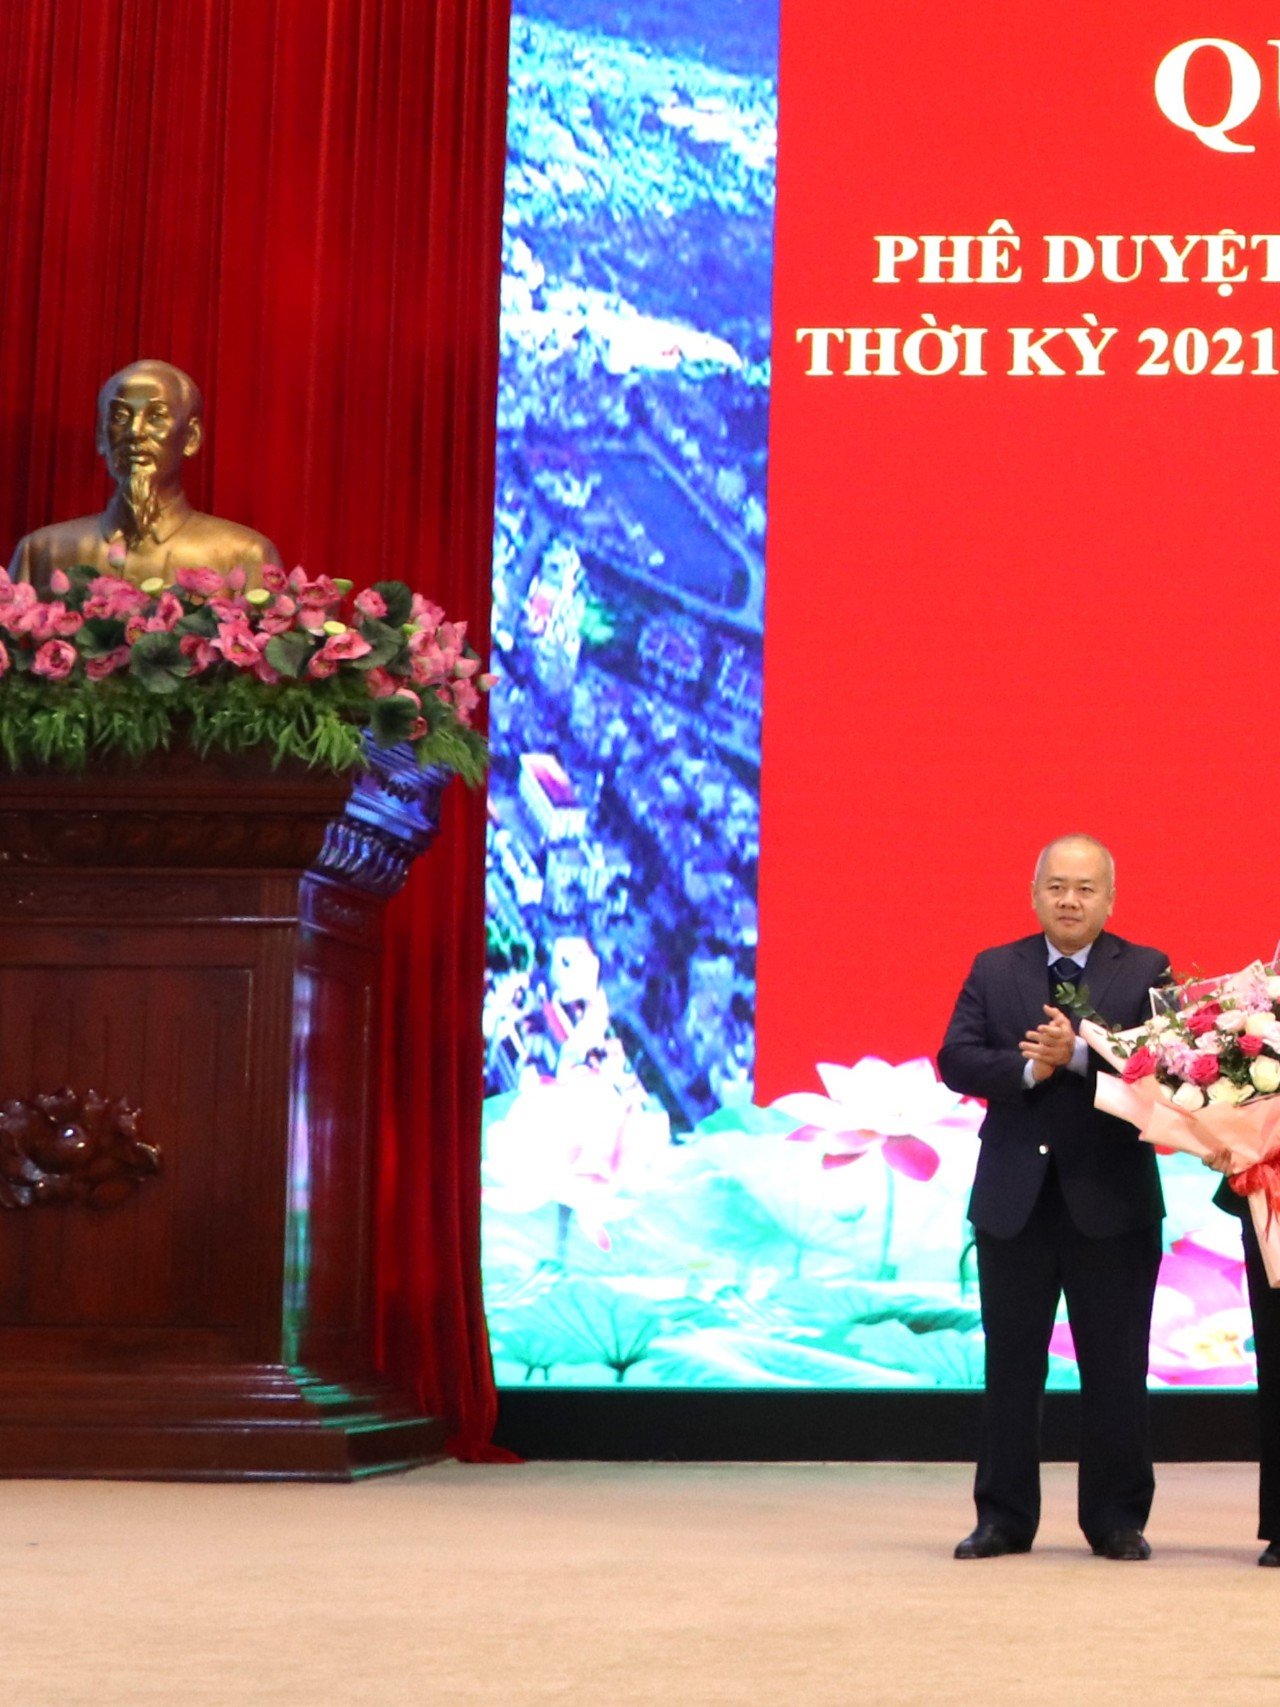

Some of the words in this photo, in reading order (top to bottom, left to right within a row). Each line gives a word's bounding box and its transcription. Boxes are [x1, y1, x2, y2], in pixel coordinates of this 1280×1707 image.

[872, 218, 1023, 284] PHÊ
[796, 312, 988, 377] THỜI
[1006, 312, 1119, 377] KỲ
[1136, 327, 1280, 376] 2021
